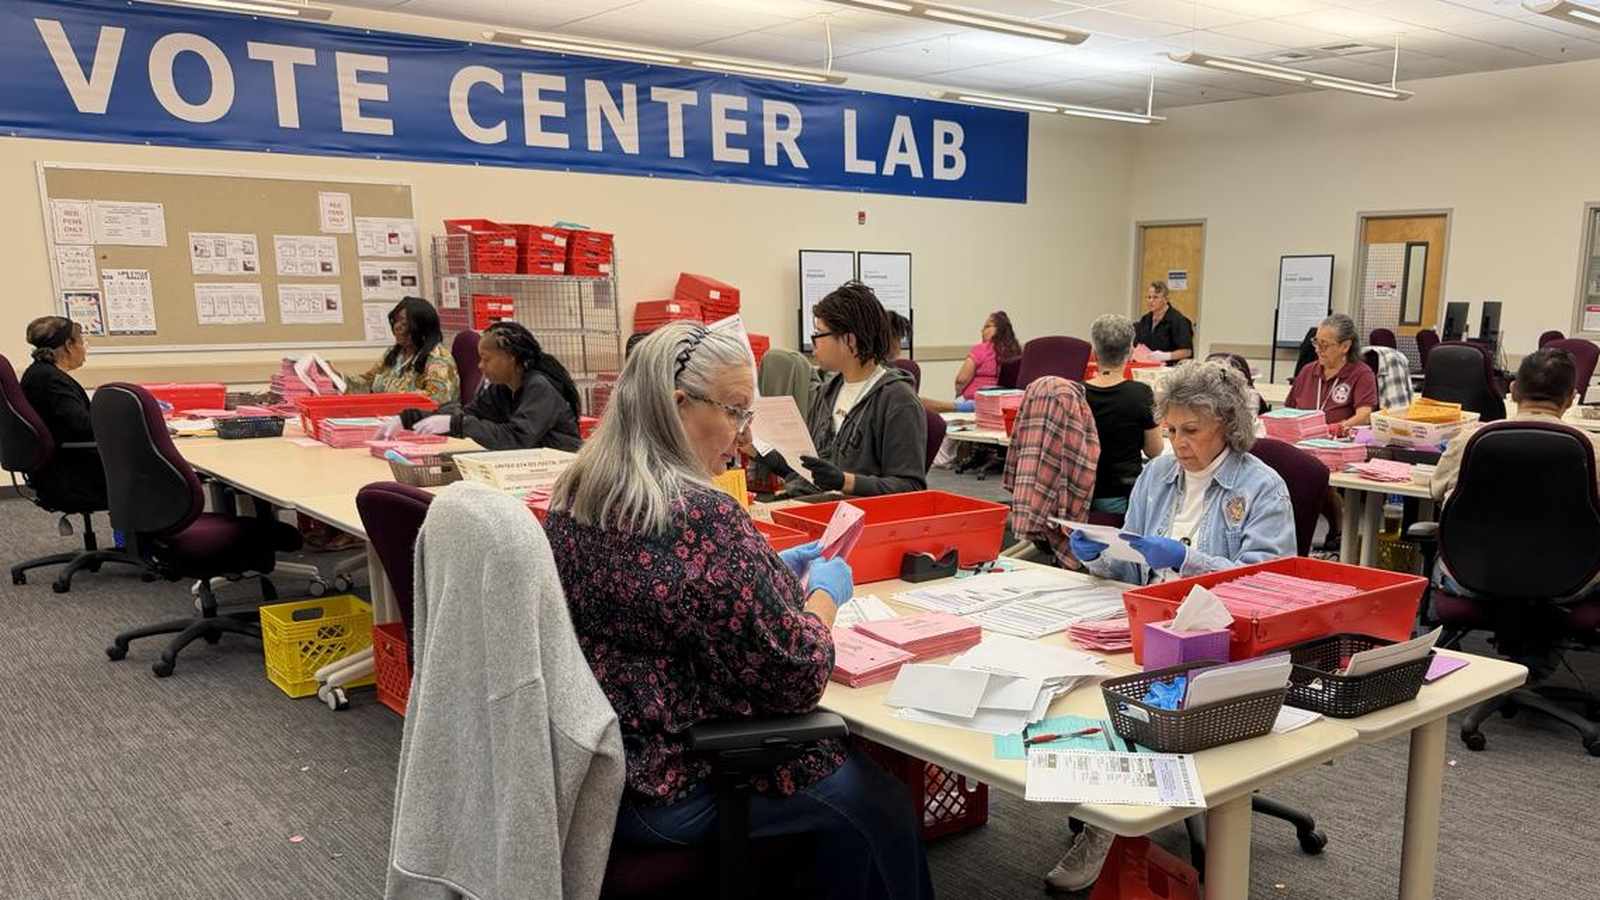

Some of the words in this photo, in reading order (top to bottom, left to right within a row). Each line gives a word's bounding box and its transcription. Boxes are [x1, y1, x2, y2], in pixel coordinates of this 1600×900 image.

[33, 17, 396, 136] VOTE
[448, 65, 810, 170] CENTER
[843, 108, 968, 182] LAB
